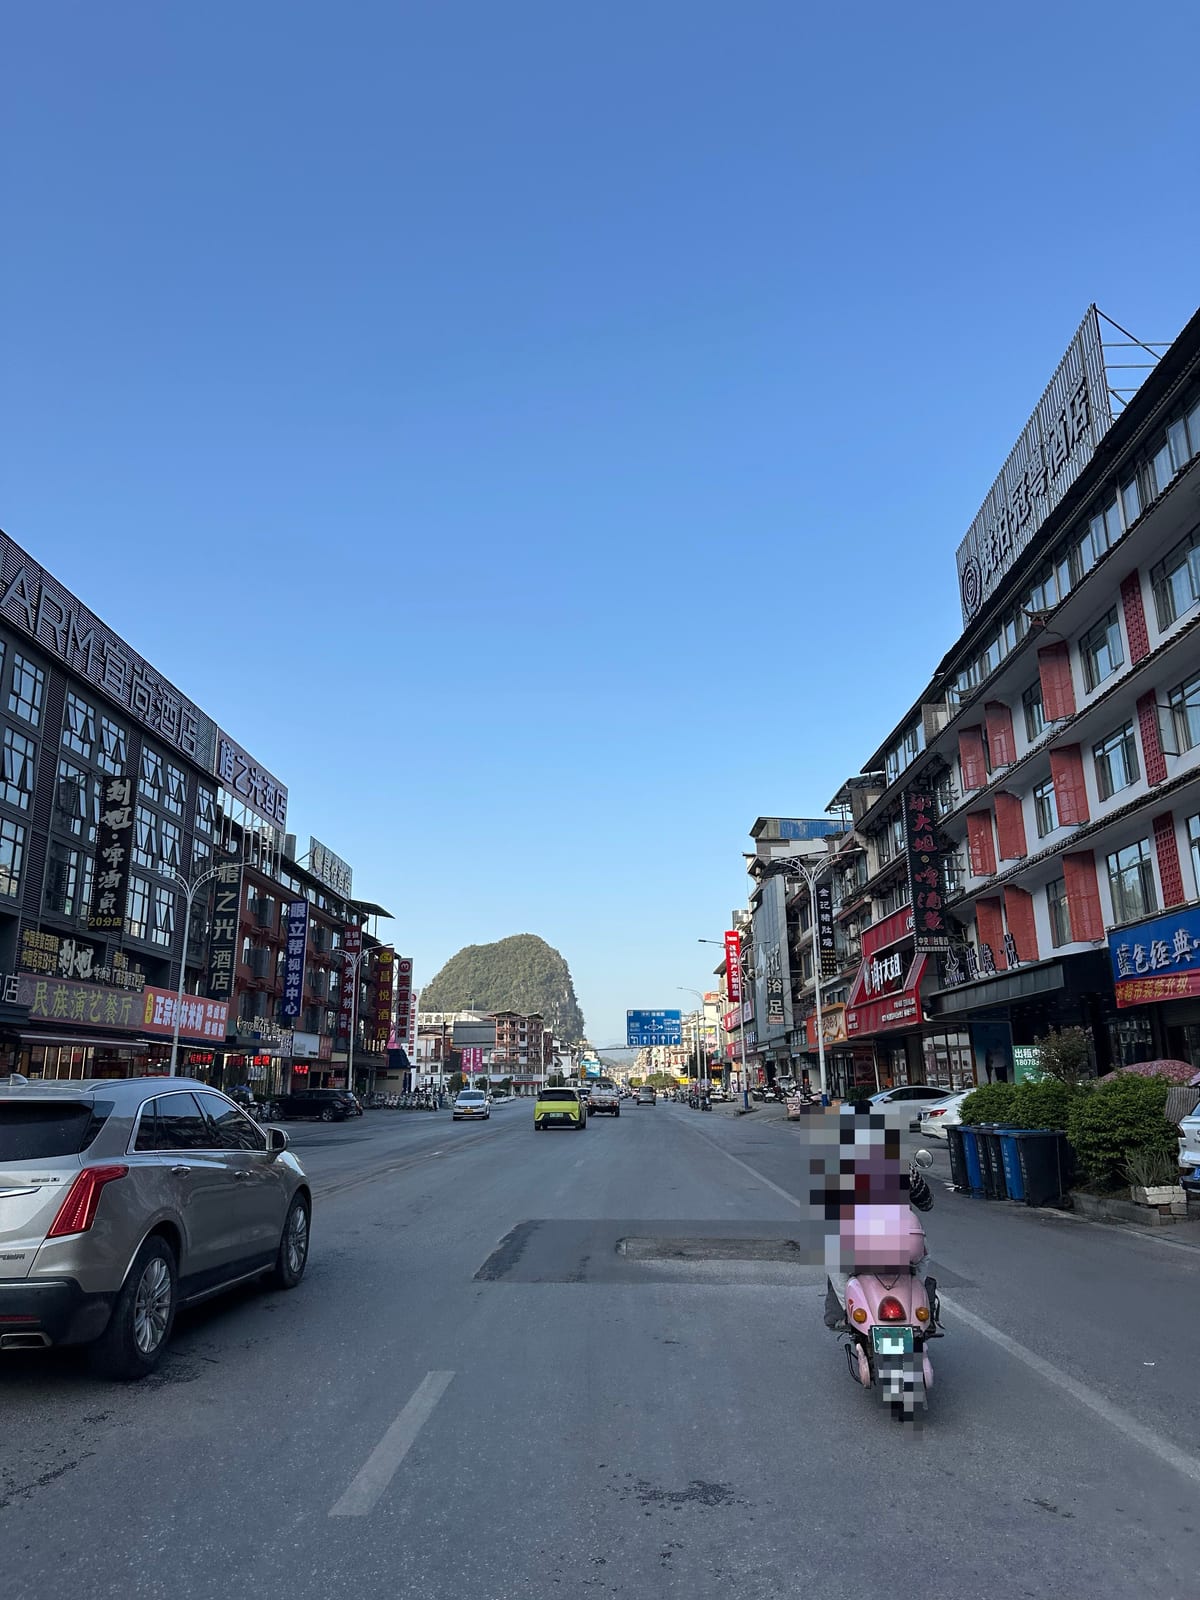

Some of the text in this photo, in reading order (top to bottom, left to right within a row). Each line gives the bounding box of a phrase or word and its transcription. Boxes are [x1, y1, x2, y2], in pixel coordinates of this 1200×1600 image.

[0, 552, 96, 675] ARM
[218, 738, 288, 827] 橙之光酒店
[88, 917, 123, 928] 20分店
[210, 861, 240, 991] 橙之光酒店
[0, 973, 20, 1003] 店
[284, 902, 306, 1016] 眼立帮视光中心
[342, 952, 354, 1009] 秀米粉
[31, 981, 133, 1026] 民族演艺餐厅
[377, 970, 390, 1040] 昌悦酒店
